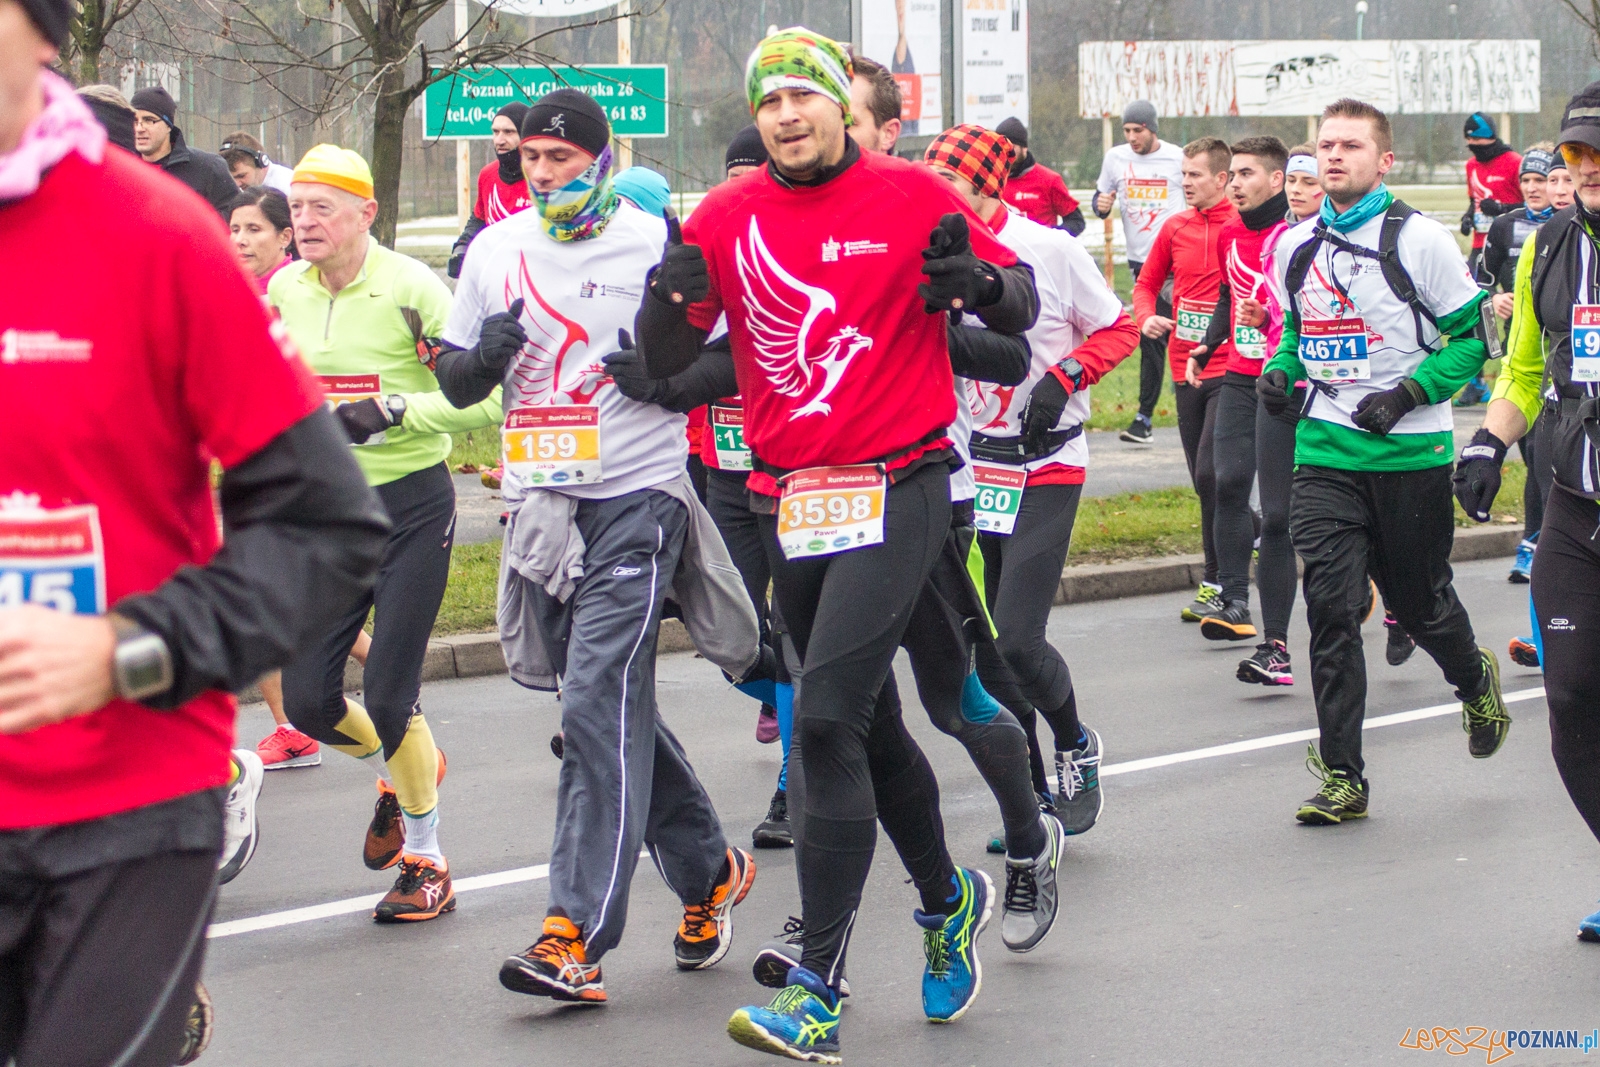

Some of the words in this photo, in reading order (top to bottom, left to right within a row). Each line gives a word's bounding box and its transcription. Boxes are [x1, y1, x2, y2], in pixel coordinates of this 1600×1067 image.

[462, 81, 514, 97] Poznań
[617, 81, 634, 97] 26
[611, 105, 627, 121] 61
[630, 105, 647, 121] 83
[1131, 188, 1164, 199] 7147
[1181, 313, 1210, 330] 938
[1305, 338, 1358, 359] 4671
[1575, 338, 1582, 347] E
[521, 432, 577, 459] 159
[716, 434, 722, 442] C
[827, 474, 877, 484] RunPoland.org
[984, 473, 1019, 484] RunPoland.org
[788, 494, 872, 528] 3598
